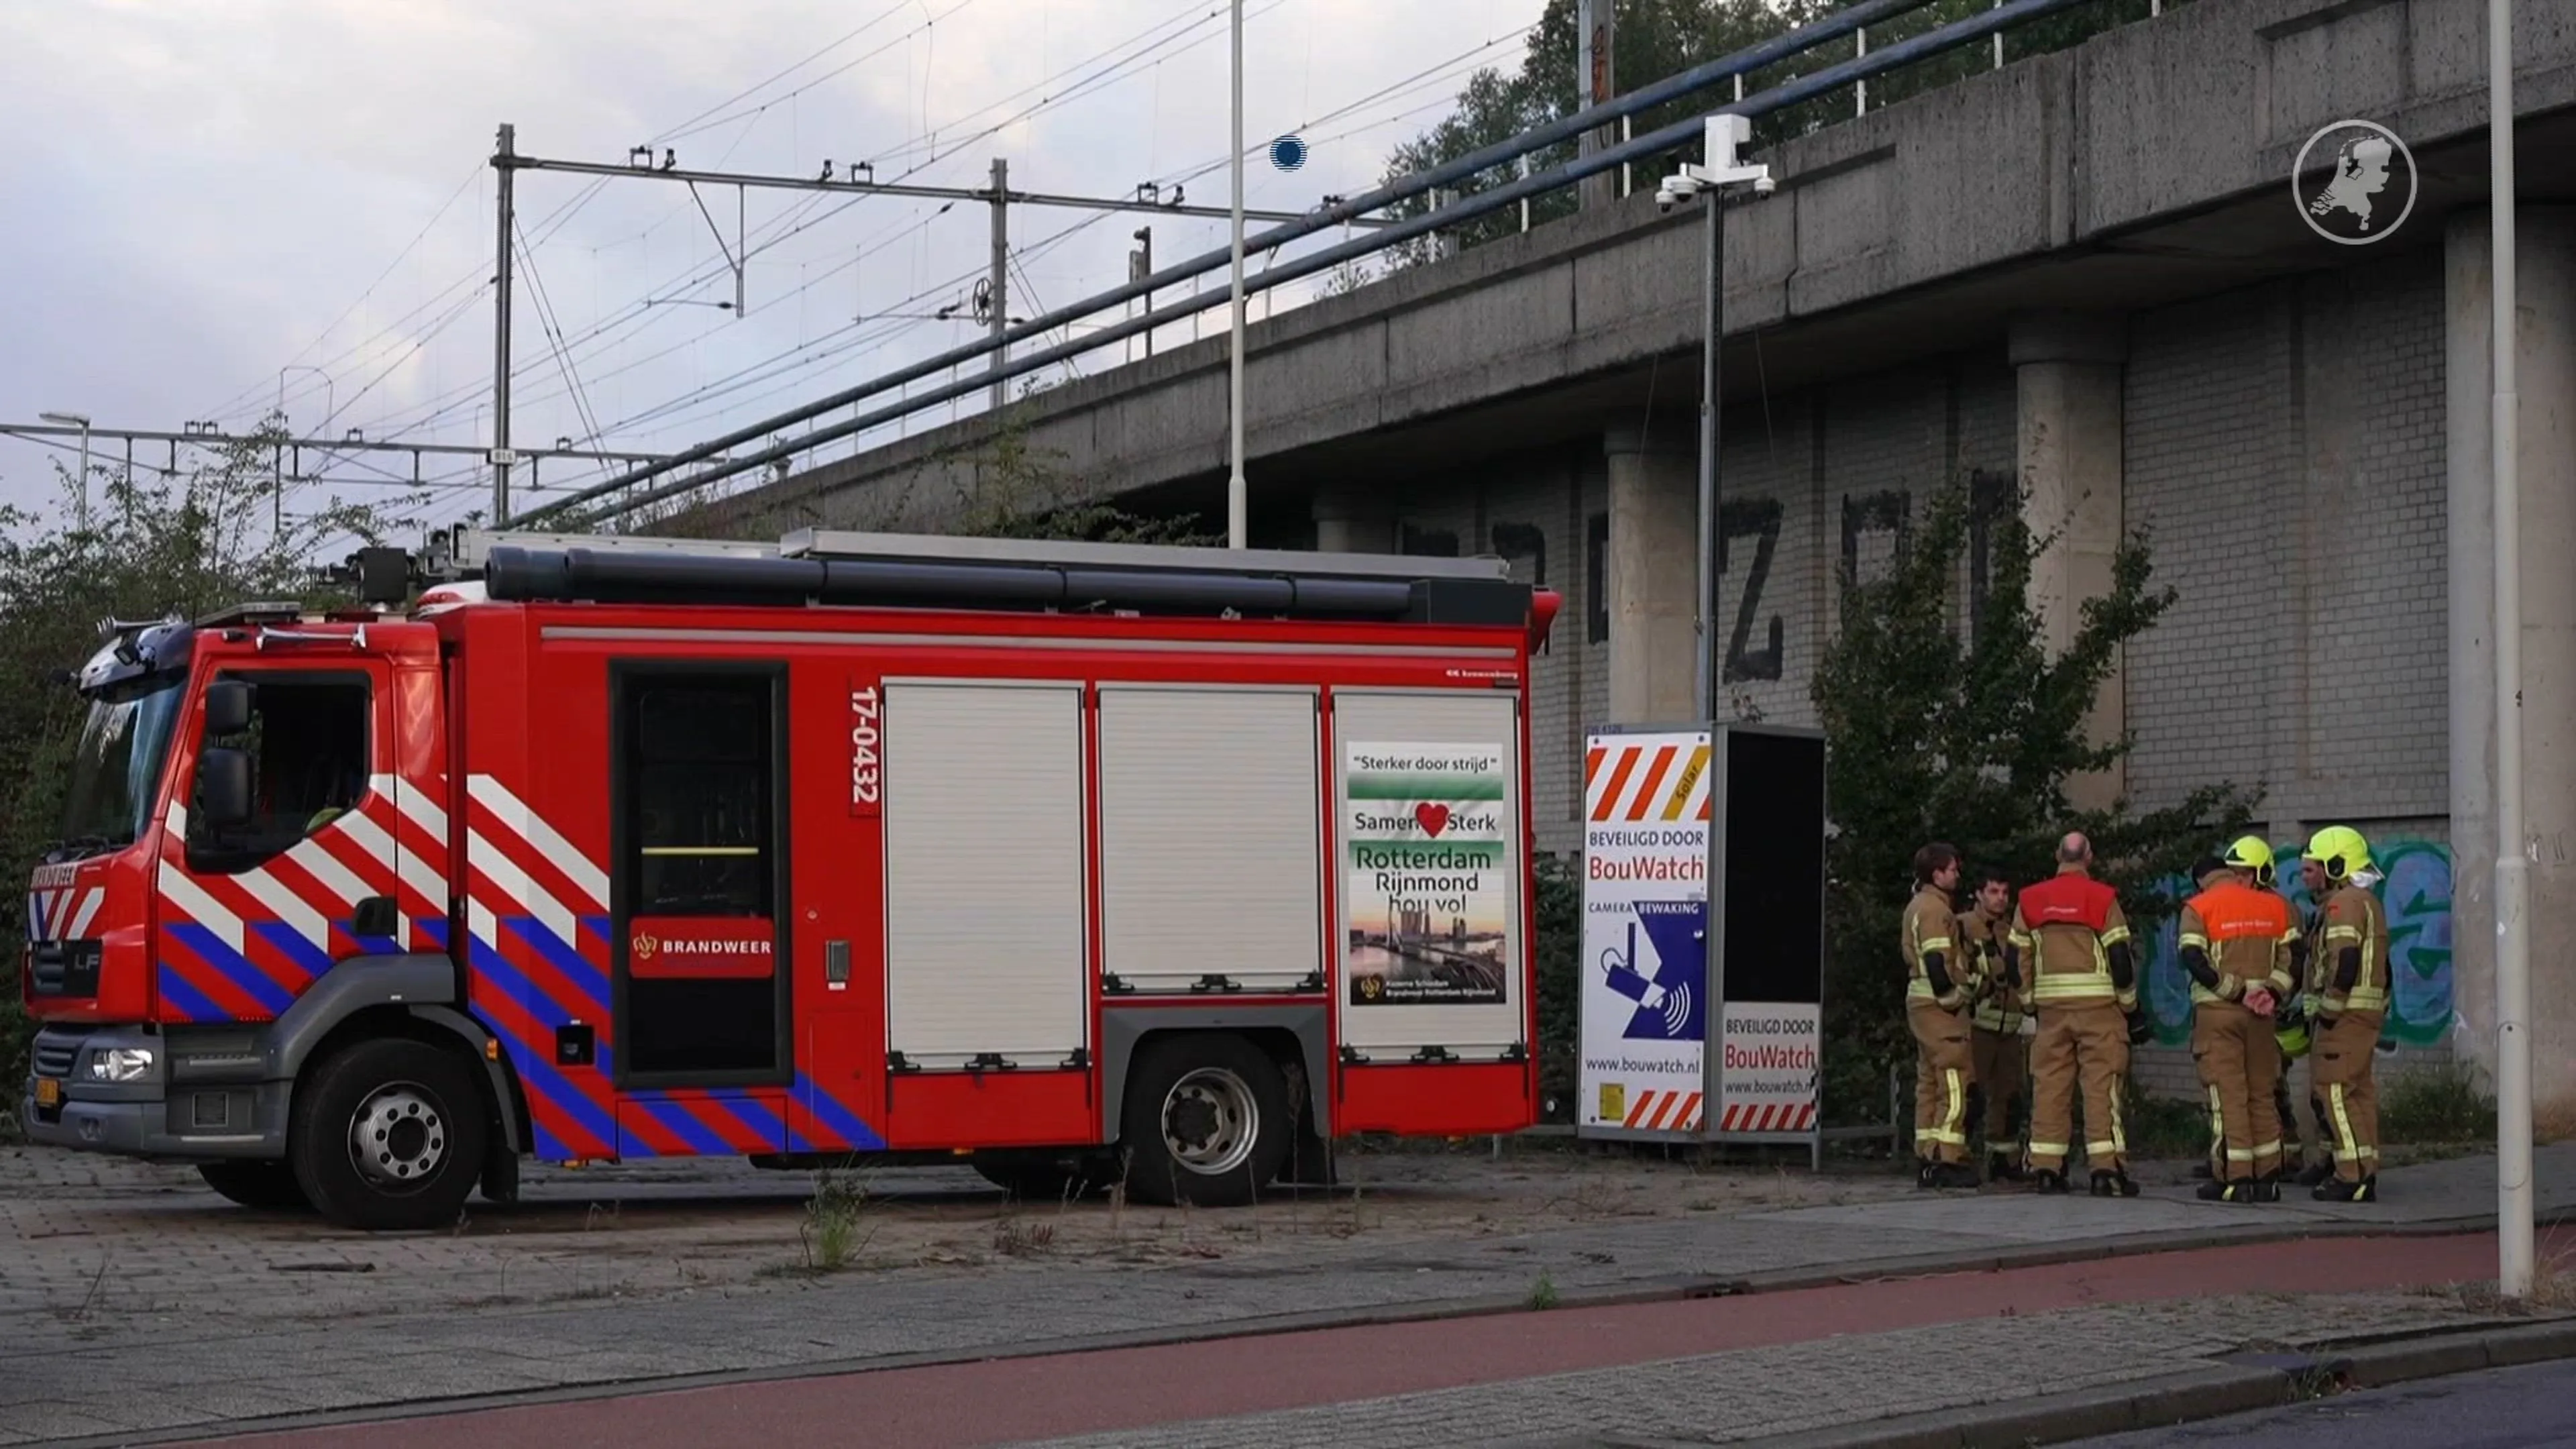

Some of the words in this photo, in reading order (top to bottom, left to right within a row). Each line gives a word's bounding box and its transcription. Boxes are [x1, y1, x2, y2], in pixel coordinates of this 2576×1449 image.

[851, 686, 879, 804] 17-0432
[1353, 755, 1411, 769] "Sterker
[1415, 757, 1448, 771] door
[1676, 764, 1701, 800] Solar
[1354, 812, 1419, 830] Samen
[1447, 813, 1496, 831] Sterk
[1589, 830, 1659, 847] BEVEILIGD
[1662, 830, 1704, 846] DOOR
[1356, 847, 1491, 870] Rotterdam
[1589, 854, 1704, 881] BouWatch
[1376, 872, 1479, 896] Rijnmond
[1389, 894, 1430, 913] hou
[1435, 894, 1466, 914] vol
[1588, 902, 1632, 914] CAMERA
[1638, 902, 1699, 914] BEWAKING
[662, 941, 771, 954] BRANDWEER
[74, 953, 99, 971] LF
[1726, 1019, 1781, 1035] BEVEILIGD
[1782, 1019, 1815, 1035] DOOR
[1585, 1056, 1700, 1074] www.bouwatch.nl
[1725, 1044, 1817, 1069] BouWatch
[1724, 1079, 1812, 1093] www.bouwatch.n
